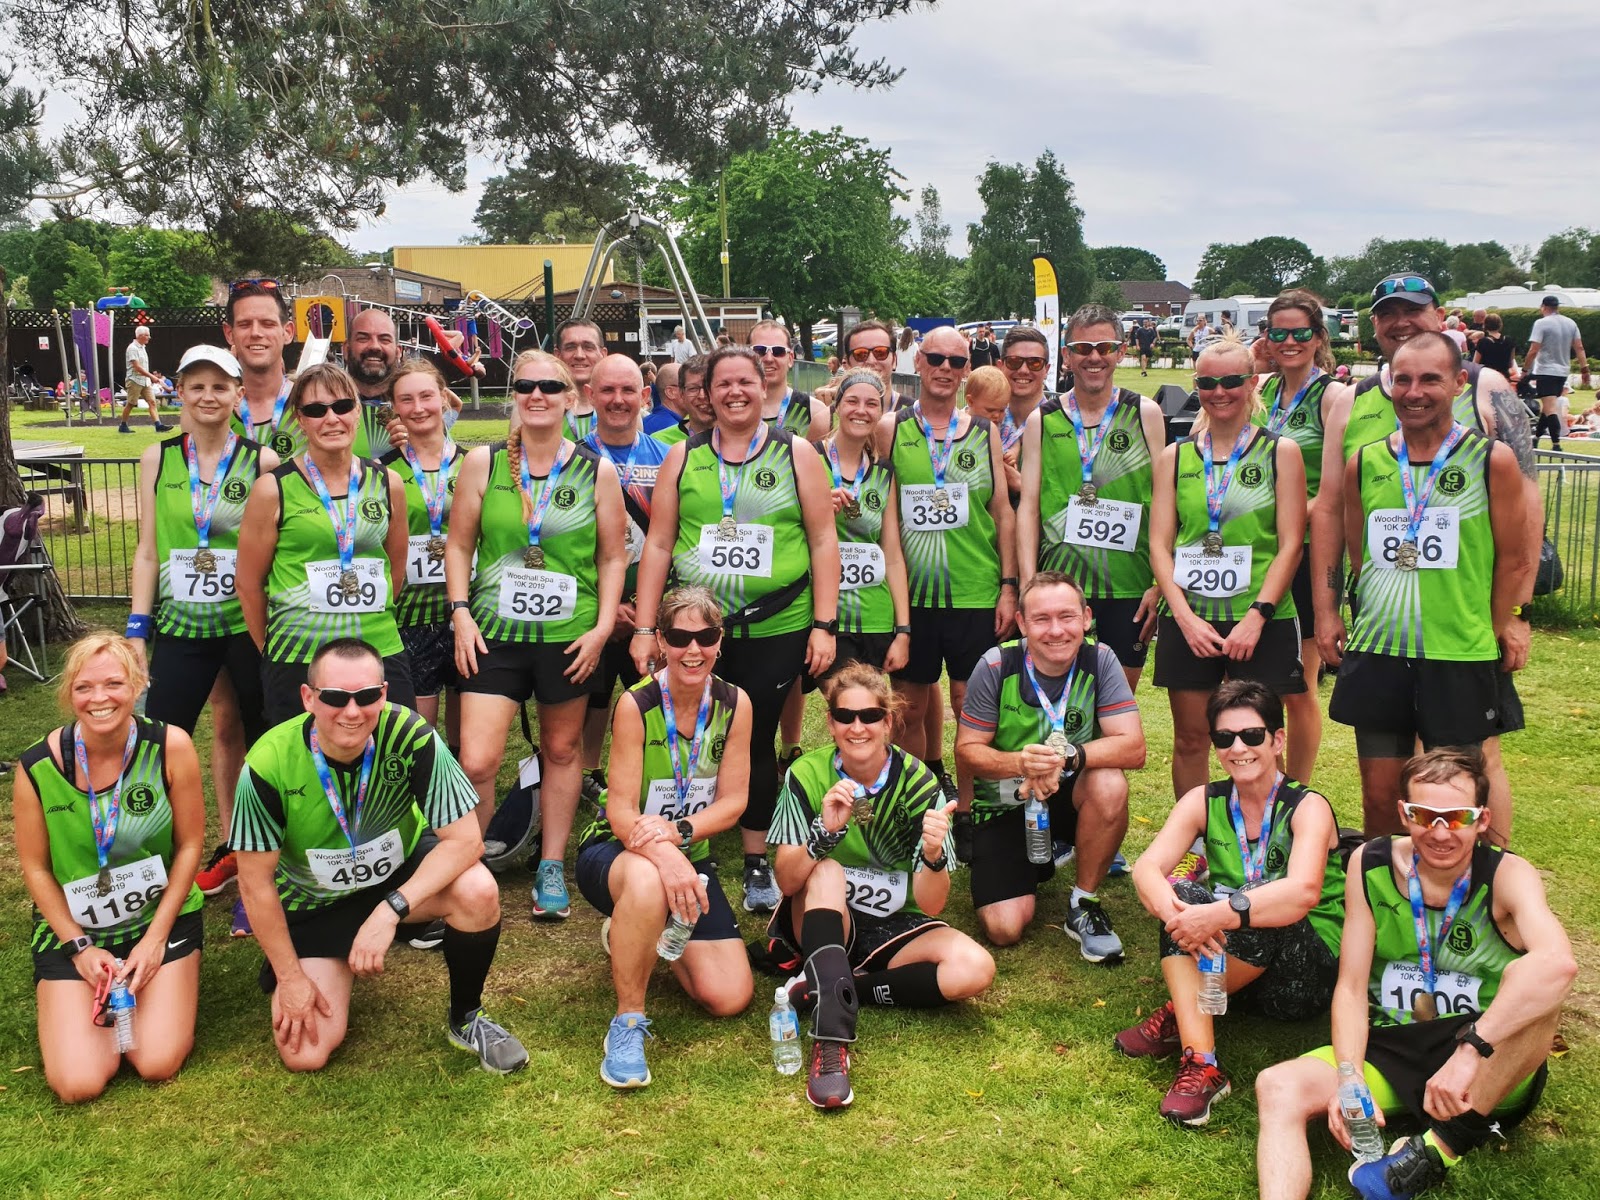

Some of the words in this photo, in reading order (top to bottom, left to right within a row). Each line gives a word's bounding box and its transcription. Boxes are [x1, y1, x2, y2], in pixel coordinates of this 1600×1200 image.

[1445, 470, 1459, 483] G
[1443, 482, 1460, 491] RC
[1105, 504, 1120, 512] Spa
[912, 504, 958, 526] 338
[1374, 514, 1410, 523] Woodhal
[738, 529, 753, 537] Spa
[1077, 518, 1126, 545] 592
[1383, 535, 1442, 562] 86
[711, 545, 760, 570] 563
[507, 572, 539, 581] Woodhall
[540, 575, 554, 584] Spa
[1187, 569, 1238, 592] 290
[185, 573, 236, 597] 759
[512, 591, 562, 616] 532
[689, 784, 704, 792] Spa
[131, 788, 147, 802] G
[133, 800, 150, 811] RC
[314, 852, 353, 860] Woodhal
[356, 847, 374, 856] Spa
[115, 871, 134, 882] Spa
[331, 857, 392, 885] 496
[857, 871, 875, 881] 2019
[846, 880, 892, 912] 922
[81, 884, 163, 925] 1186
[1400, 972, 1415, 980] 10K
